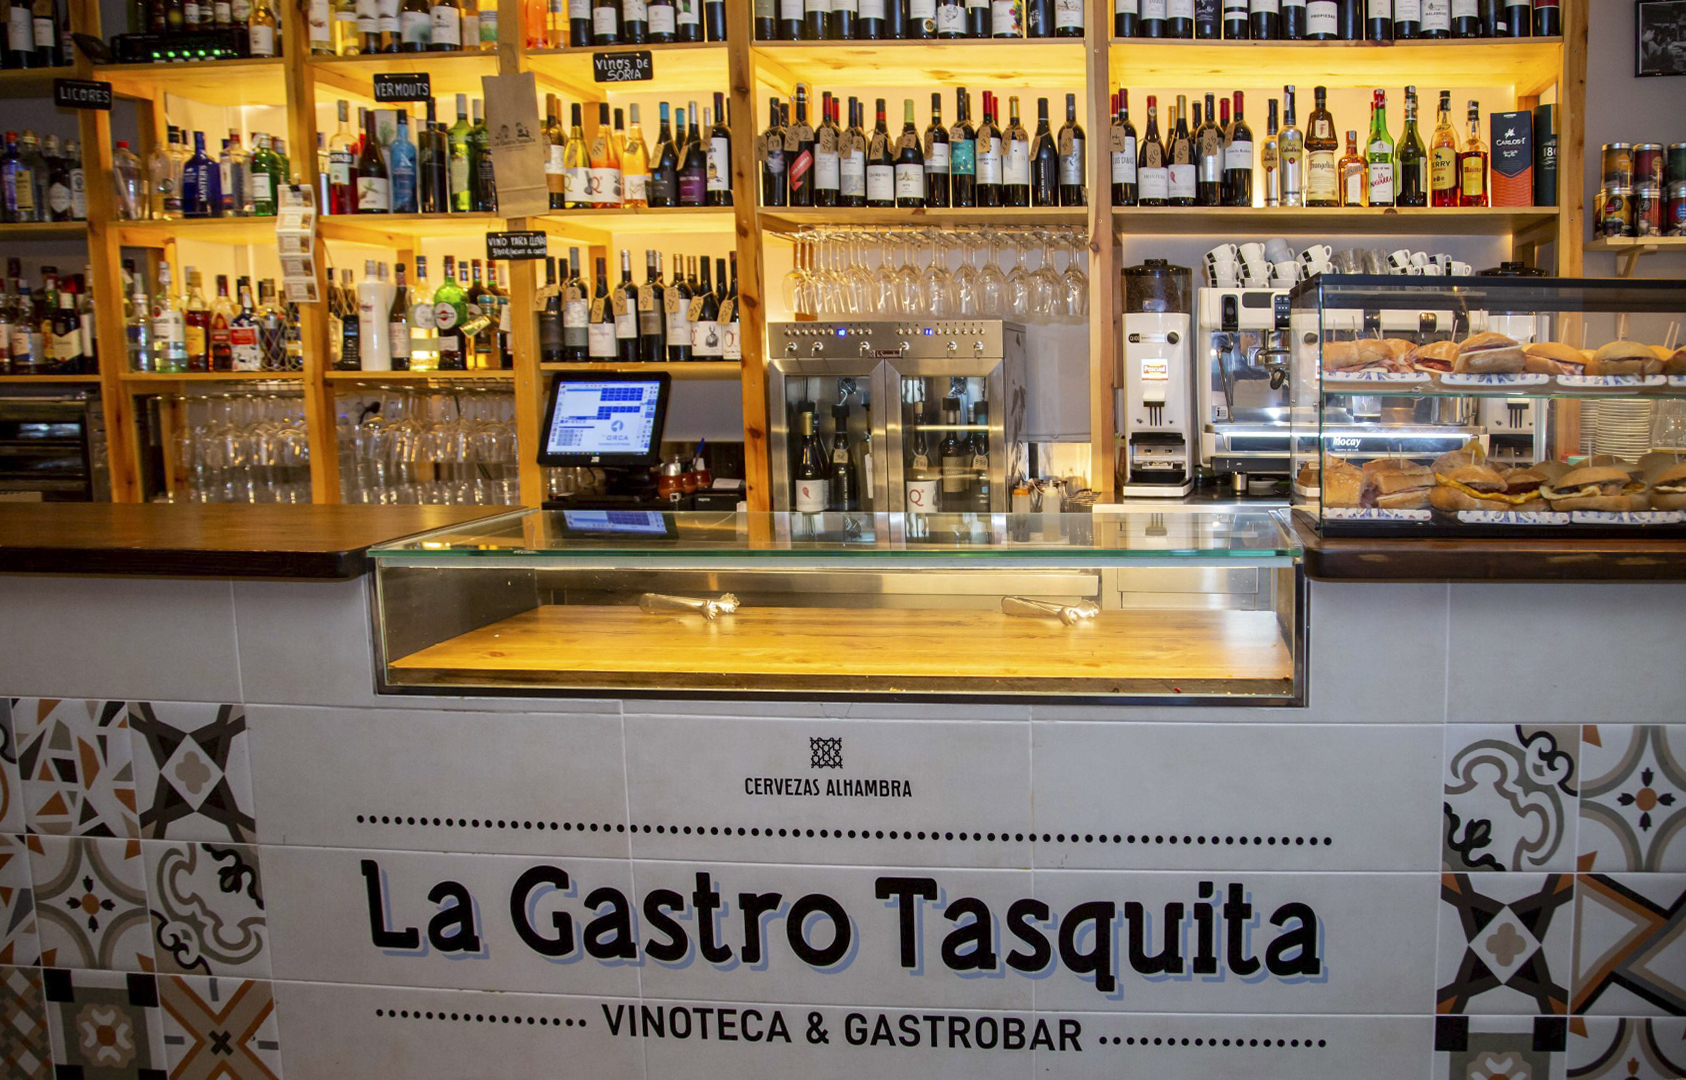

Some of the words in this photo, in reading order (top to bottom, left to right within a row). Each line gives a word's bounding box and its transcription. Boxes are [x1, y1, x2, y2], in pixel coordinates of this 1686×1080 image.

[636, 59, 649, 69] DE
[606, 69, 642, 81] SORIA
[59, 86, 110, 103] LICORES
[375, 82, 429, 97] VERMOUTS
[198, 164, 208, 201] MASTER'S
[1370, 174, 1393, 188] NAVARRA
[488, 237, 508, 246] VINO
[1144, 365, 1166, 374] Pascual
[1332, 436, 1362, 448] Mocay
[744, 777, 820, 797] CERVEZAS
[826, 778, 912, 798] ALHAMBRA
[361, 858, 485, 956] La
[509, 864, 854, 970] Gastro
[875, 876, 1323, 995] Tasquita
[601, 1004, 793, 1044] VINOTECA
[805, 1011, 830, 1045] &
[843, 1012, 1083, 1053] GASTROBAR
